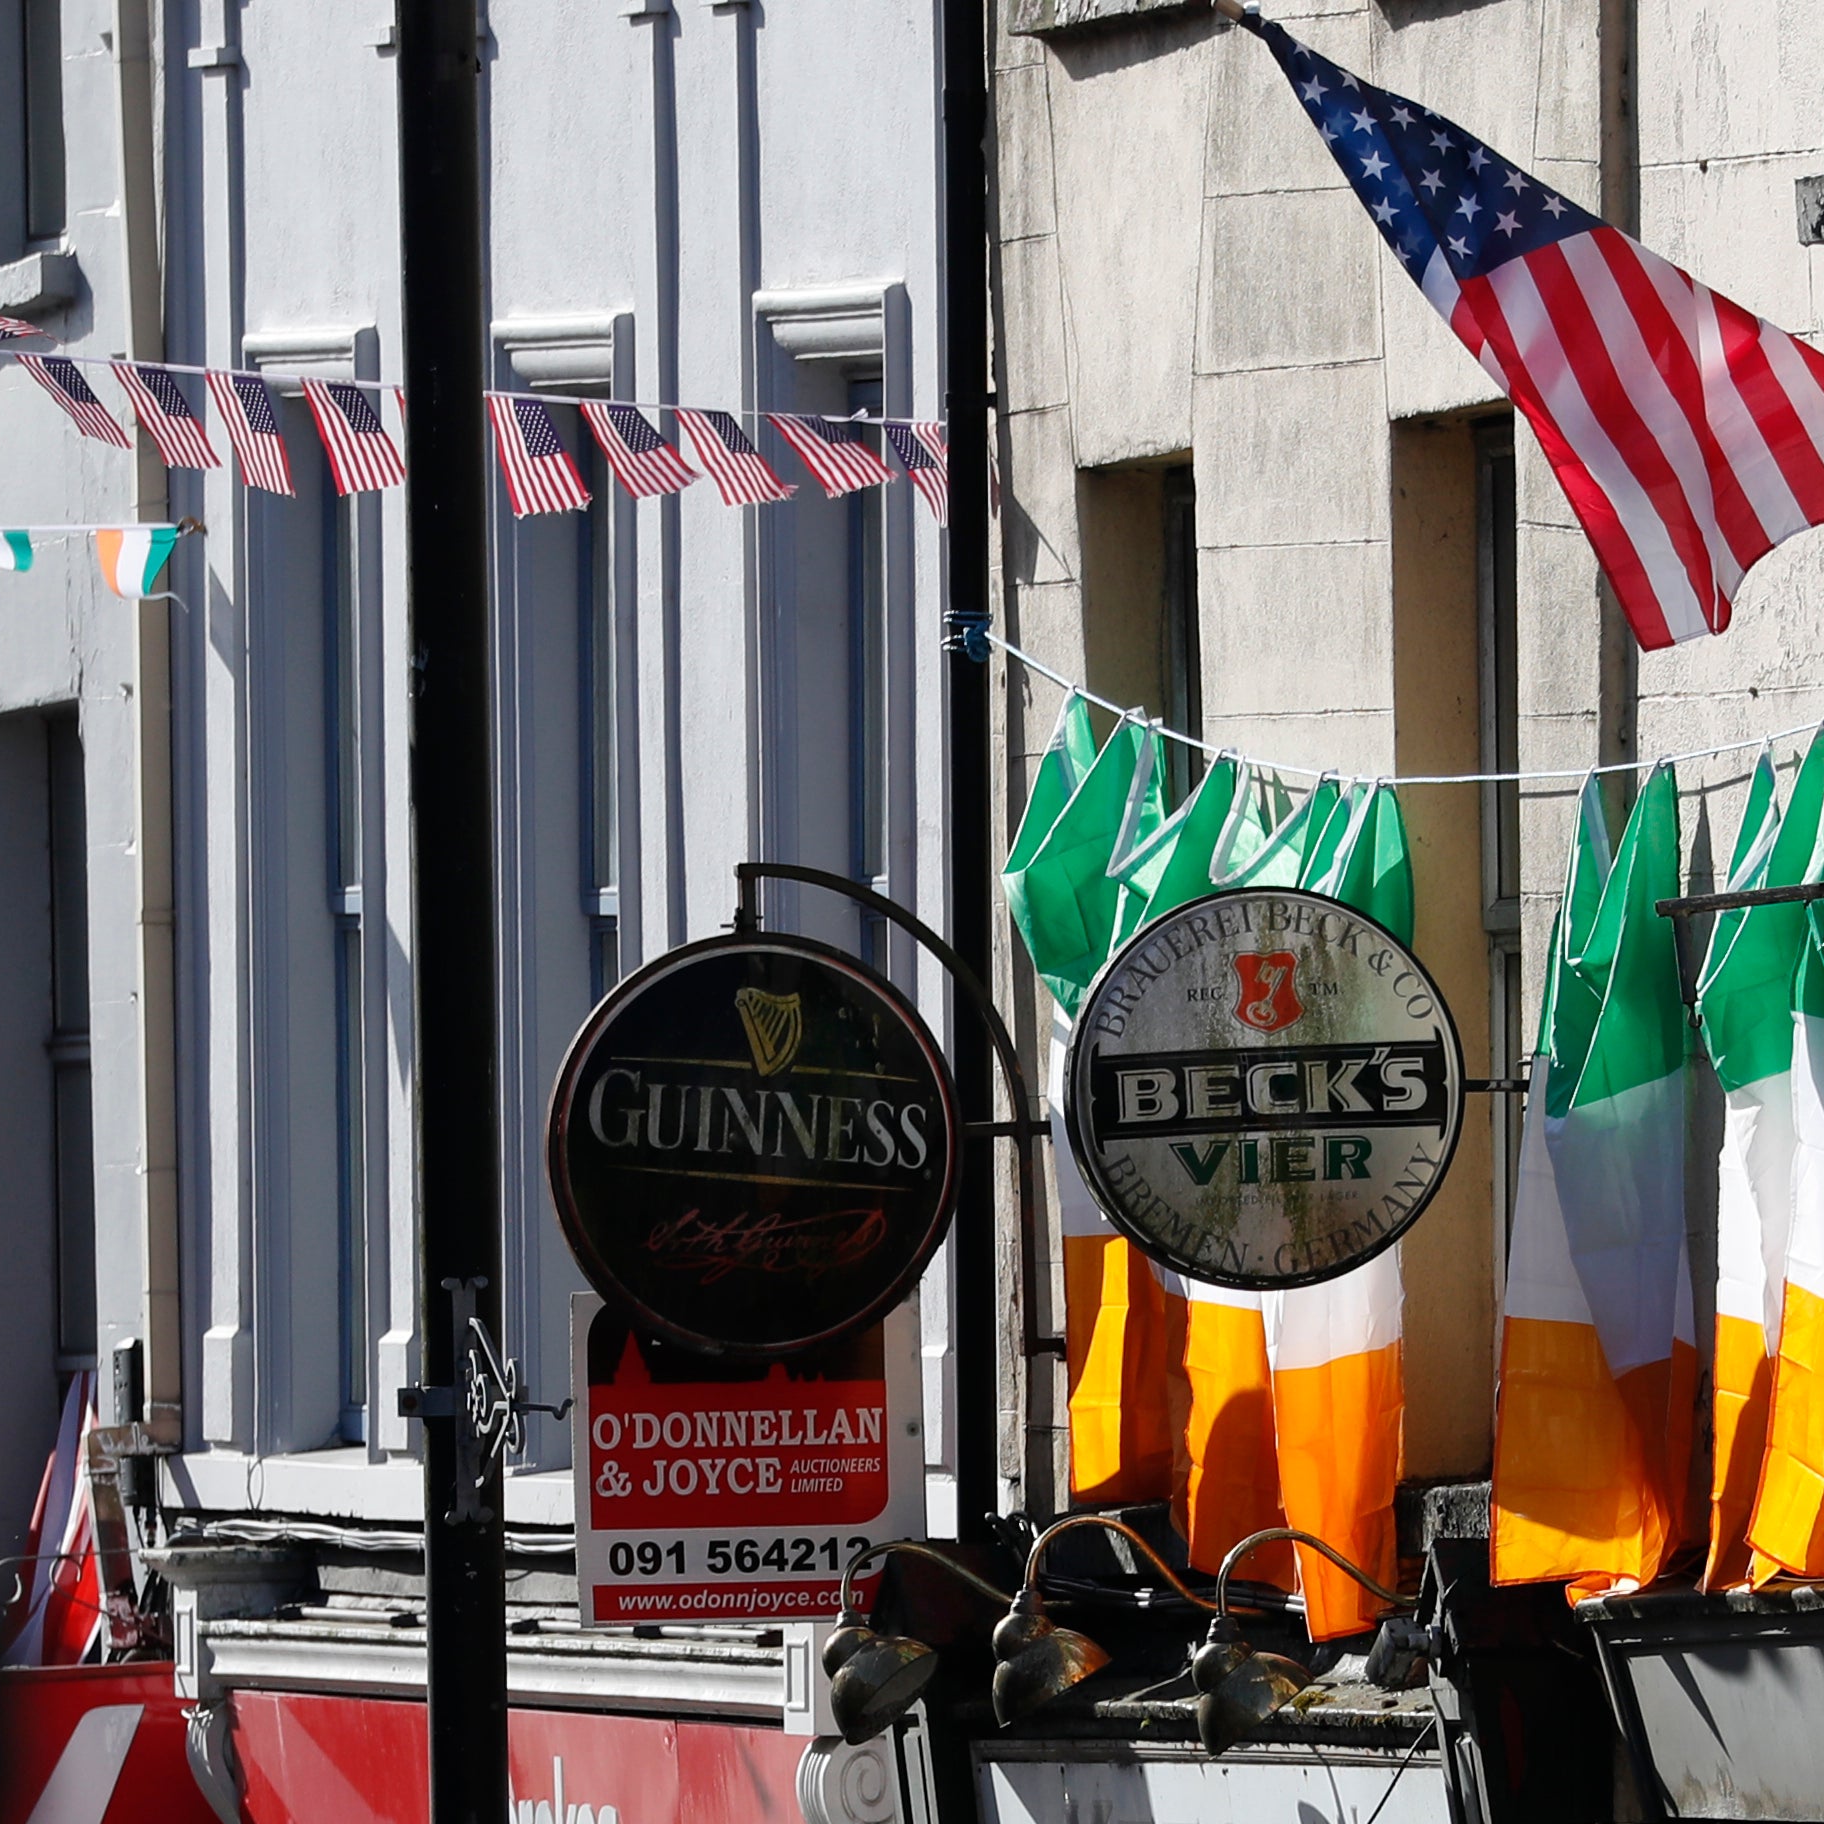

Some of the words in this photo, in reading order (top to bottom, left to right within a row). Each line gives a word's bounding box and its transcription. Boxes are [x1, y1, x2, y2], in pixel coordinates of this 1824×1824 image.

[1095, 903, 1254, 1039] BRAUEREI
[1268, 901, 1366, 957] BECK
[1367, 949, 1394, 977] &
[1392, 971, 1434, 1020] CO
[1118, 1047, 1432, 1125] BECK'S
[587, 1068, 928, 1170] GUINNESS
[1169, 1134, 1373, 1187] VIER
[1104, 1153, 1252, 1276] BREMEN
[1273, 1141, 1440, 1277] GERMANY
[591, 1406, 884, 1451] O'DONNELLAN
[594, 1459, 633, 1497] &
[642, 1456, 783, 1497] JOYCE
[789, 1457, 881, 1474] AUCTIONEERS
[790, 1477, 844, 1493] LIMITED
[608, 1539, 687, 1576] 091
[705, 1535, 873, 1575] 564212
[617, 1588, 866, 1614] www.odonnjoyce.com
